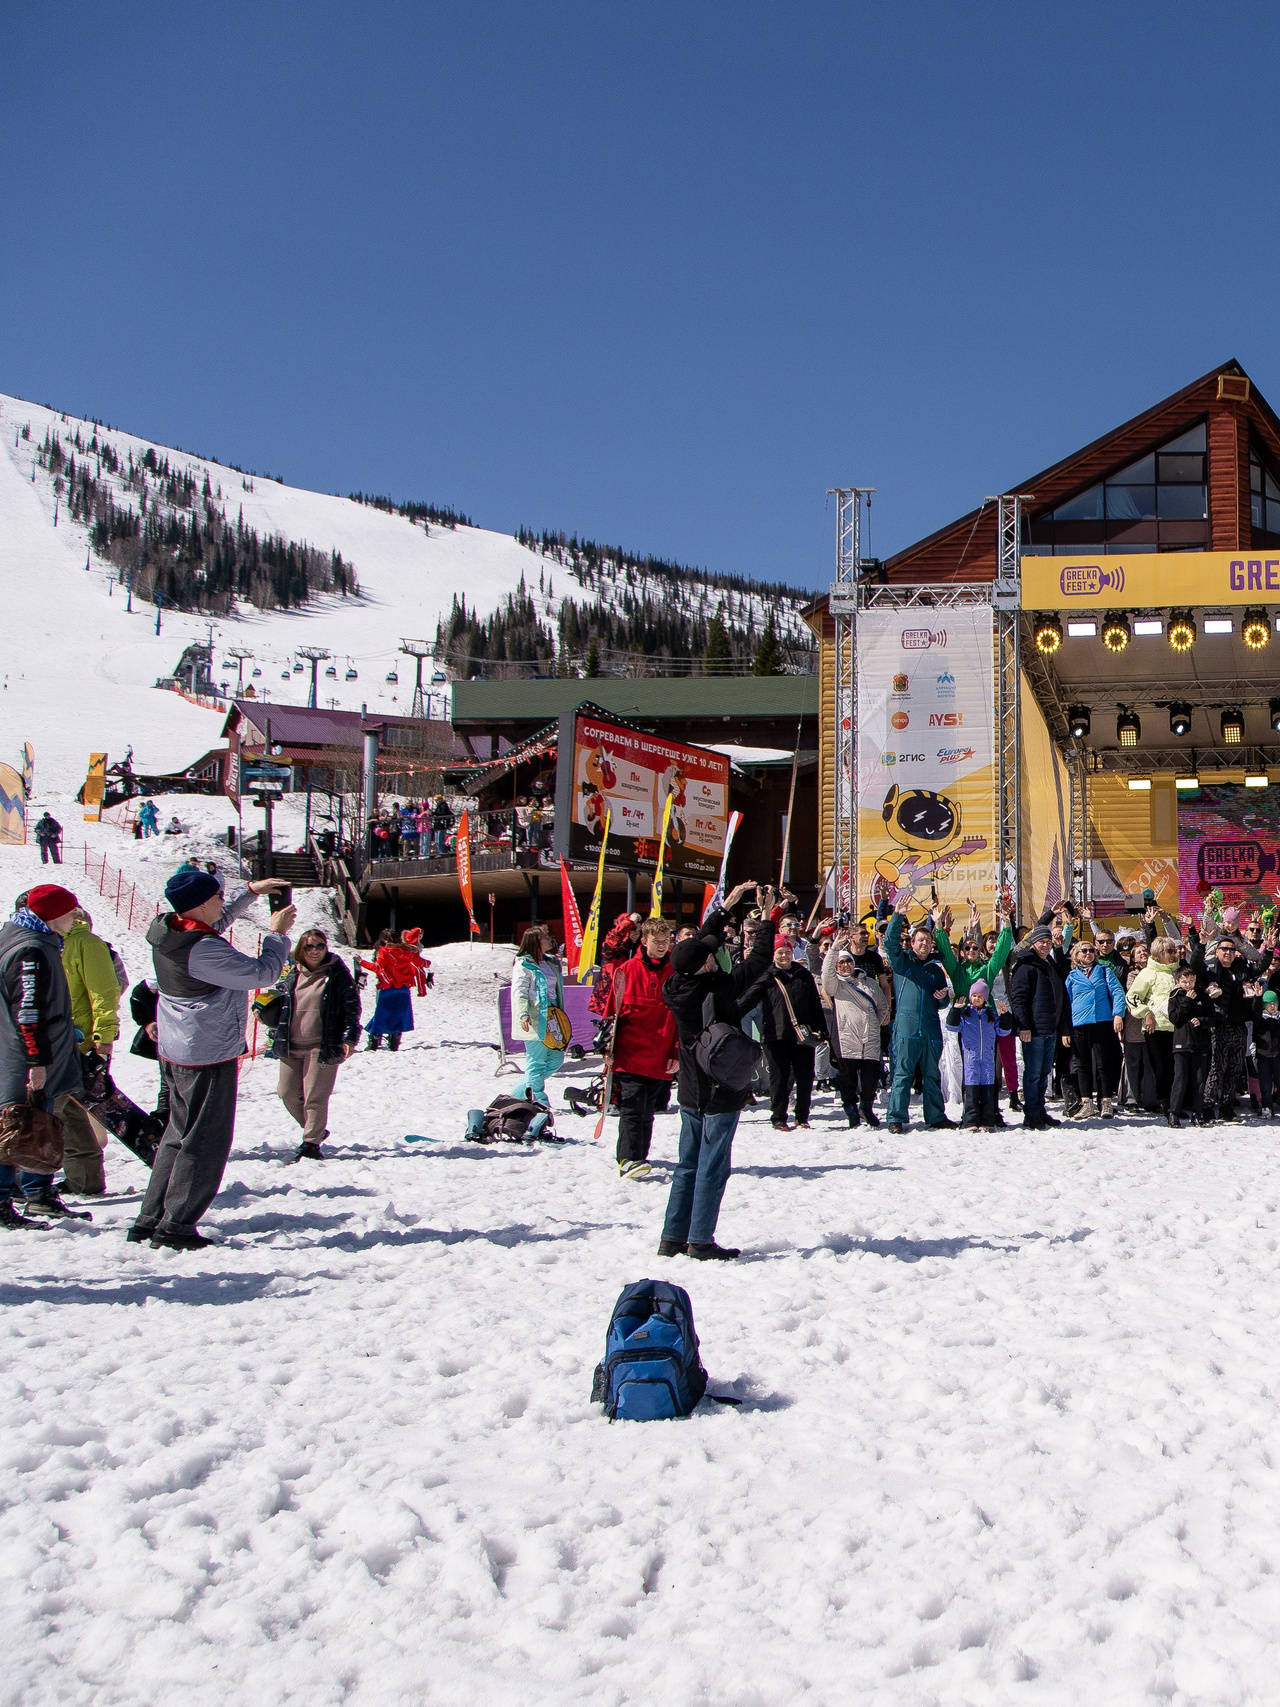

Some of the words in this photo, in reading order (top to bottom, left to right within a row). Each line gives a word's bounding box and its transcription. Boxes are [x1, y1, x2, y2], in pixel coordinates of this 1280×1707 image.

[1066, 570, 1097, 581] GRELKA
[1066, 581, 1088, 591] FEST
[905, 631, 928, 640] GRELKA
[905, 639, 921, 647] FEST
[928, 713, 963, 726] AYS!
[584, 726, 632, 748] СОГРЕВАЕМ
[633, 740, 639, 749] В
[641, 741, 681, 760] ШЕРЕГЕШЕ
[681, 753, 698, 764] УЖЕ
[698, 758, 707, 768] 10
[707, 761, 724, 772] ЛЕТ!
[899, 753, 926, 762] 2ГИС
[637, 840, 673, 861] GRELA
[1207, 847, 1256, 862] GRELKA
[1207, 864, 1240, 879] FEST
[21, 974, 36, 1008] TOUCH
[20, 1024, 38, 1056] DON'T
